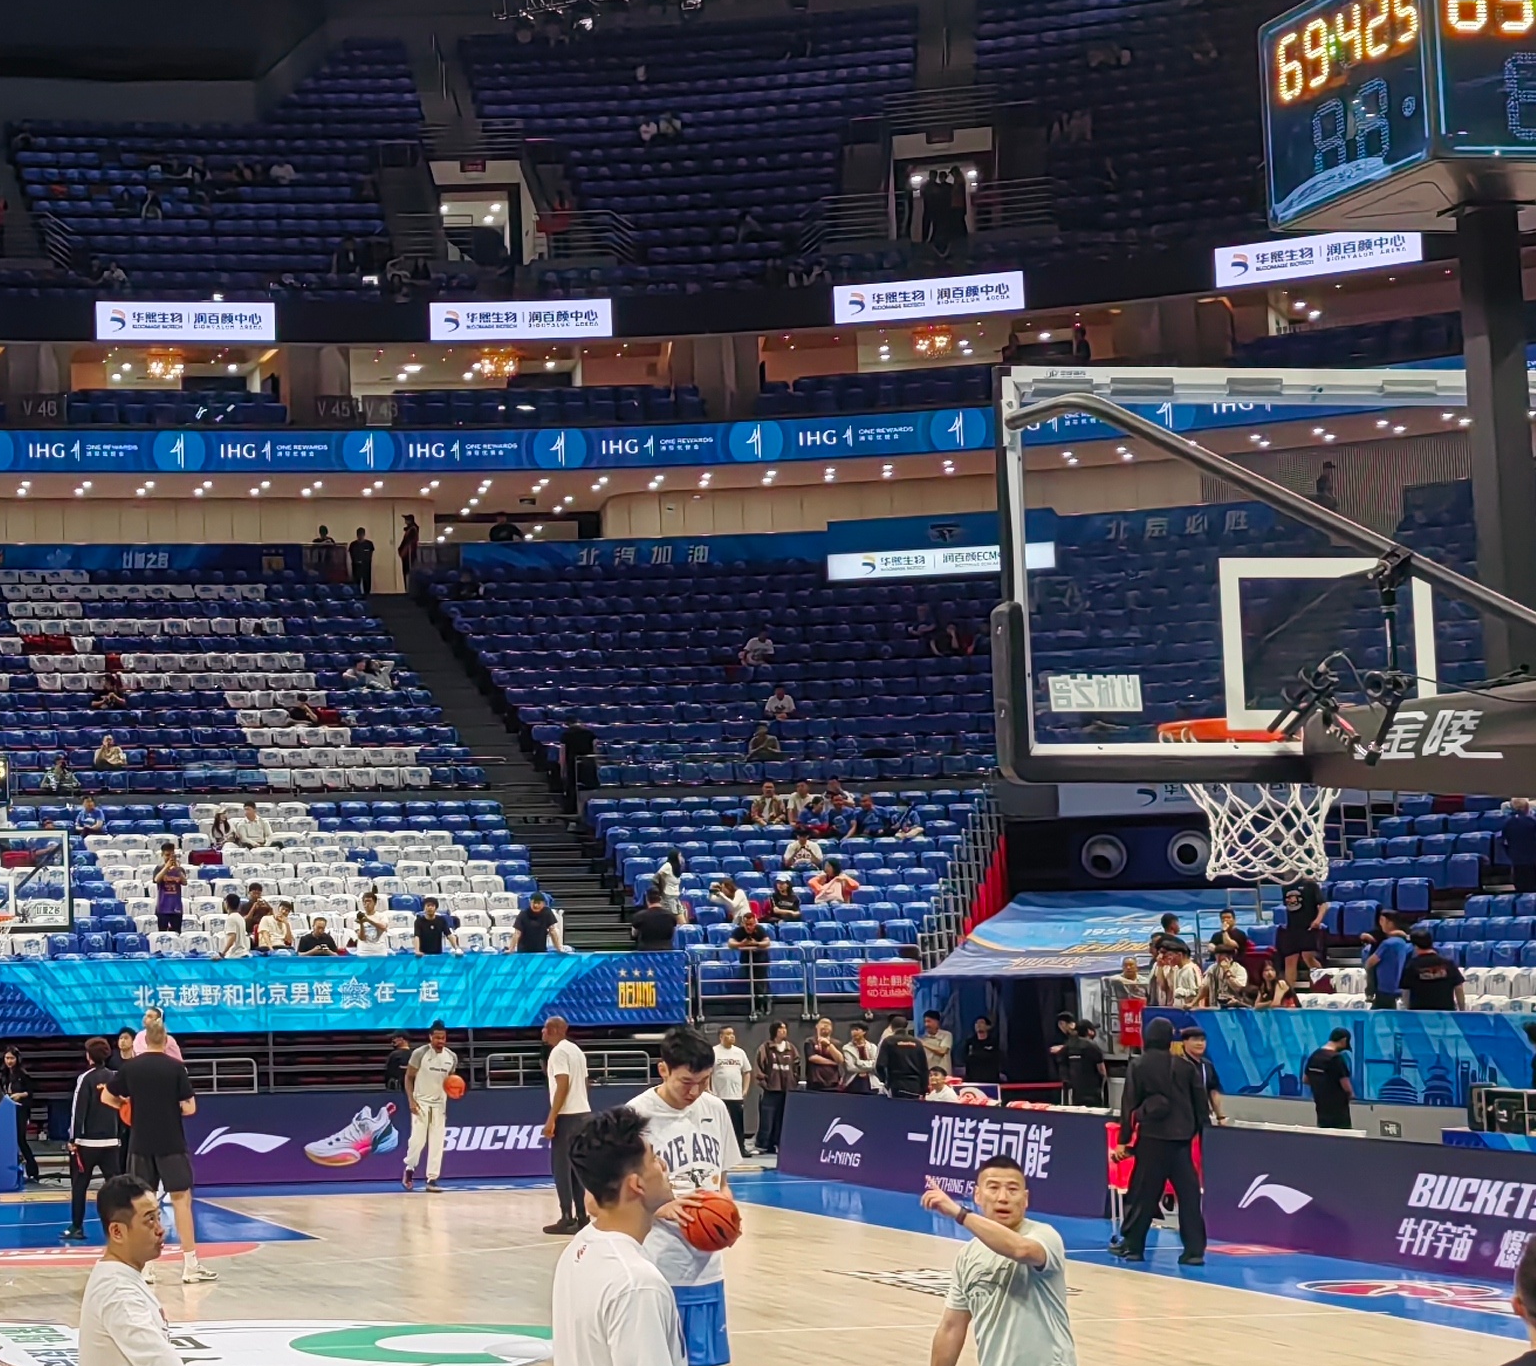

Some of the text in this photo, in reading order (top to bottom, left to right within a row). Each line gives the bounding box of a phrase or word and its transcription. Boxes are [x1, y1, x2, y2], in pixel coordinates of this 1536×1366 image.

[1256, 233, 1406, 264] 华熙生物 润百颜中心
[872, 282, 1010, 304] 华熙生物 润百颜中心
[132, 311, 262, 325] 华熙生物 润百颜中心
[466, 309, 599, 323] 华熙生物 润百颜中心
[602, 439, 639, 455] IHG
[799, 429, 837, 446] IHG
[29, 443, 66, 459] IHG
[220, 443, 256, 459] IHG
[409, 442, 446, 458] IHG
[577, 544, 710, 566] 北汽加油
[133, 980, 441, 1008] 北京越野和北京男篮 在一起
[618, 981, 656, 1008] BEIJING
[691, 1132, 721, 1167] ARE
[820, 1148, 861, 1168] LI-NING
[1395, 1217, 1478, 1262] 牛仔宇宙
